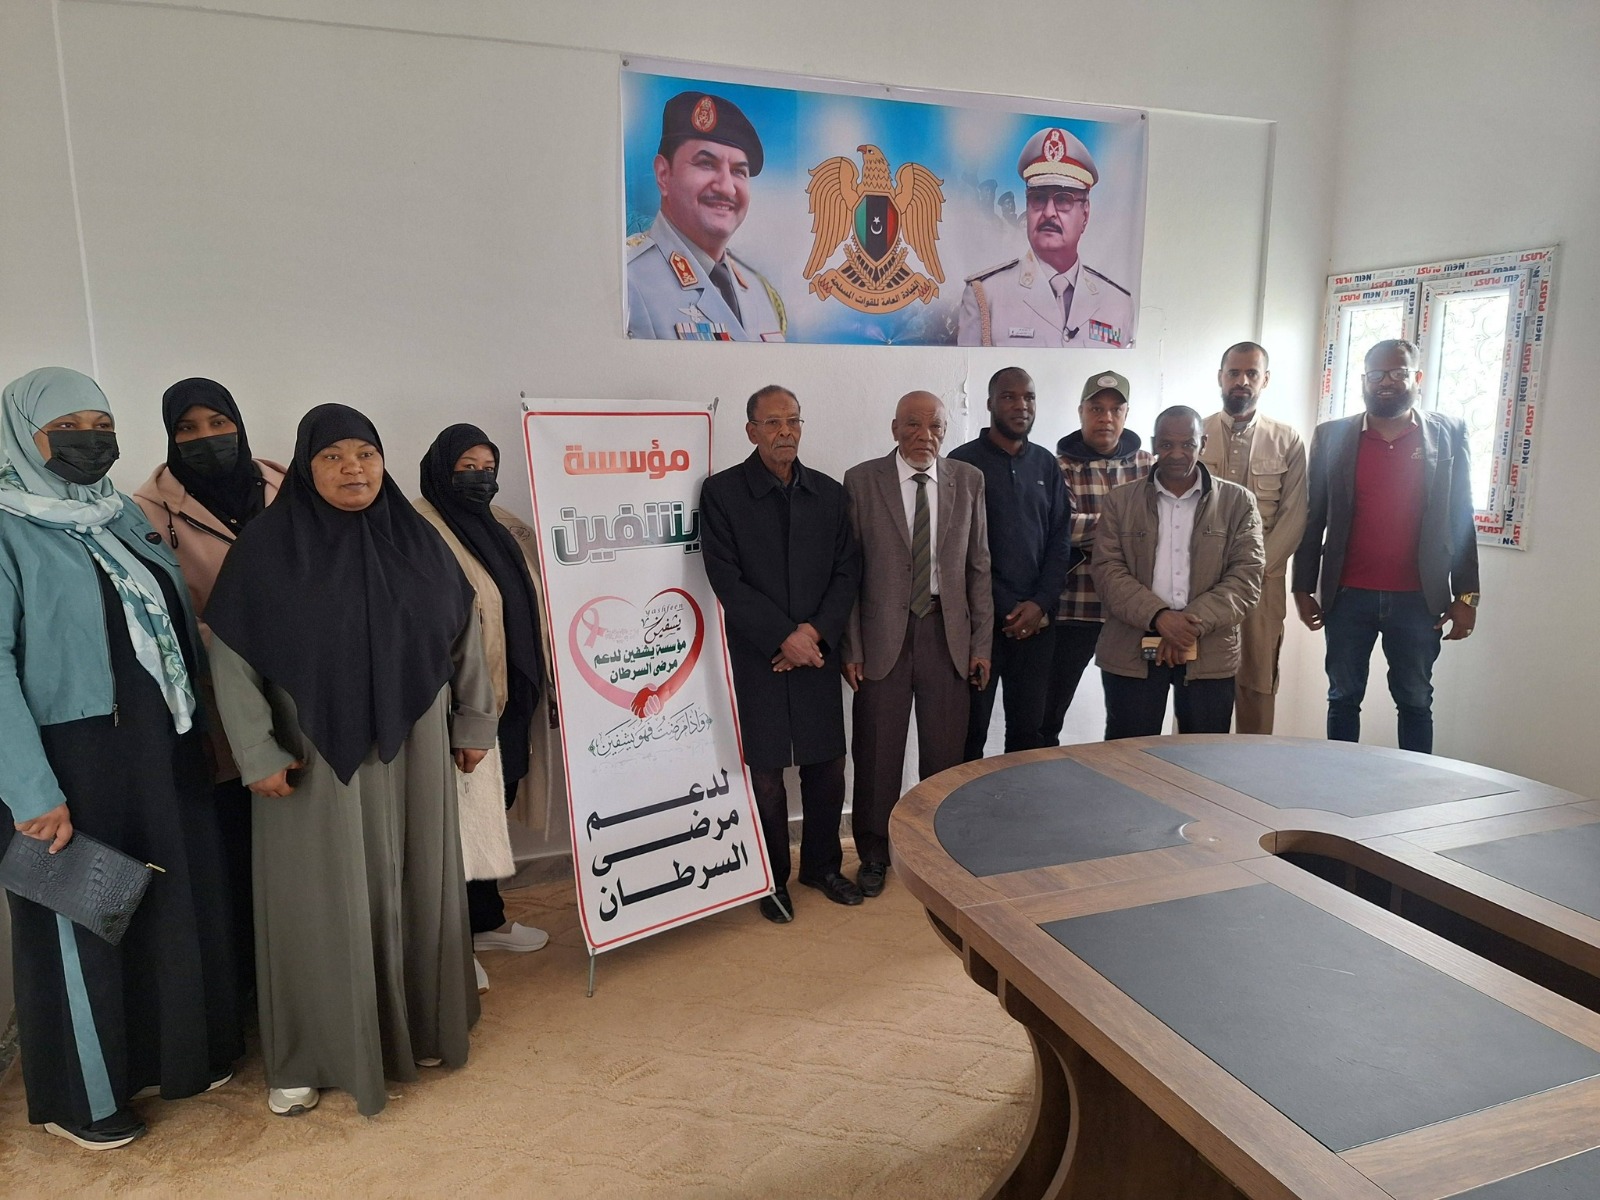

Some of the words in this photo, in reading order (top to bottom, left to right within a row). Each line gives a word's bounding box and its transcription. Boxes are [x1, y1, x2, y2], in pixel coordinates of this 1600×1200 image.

[1444, 262, 1465, 273] NEW
[830, 276, 854, 299] المسلحة
[1395, 277, 1415, 287] NEW
[1474, 276, 1501, 286] PLAST
[1504, 273, 1520, 283] EW
[855, 295, 880, 308] للقوات
[881, 295, 901, 307] العامة
[1340, 293, 1361, 302] PLAST
[1363, 291, 1381, 299] NEW
[1537, 280, 1549, 312] PLAST
[1534, 315, 1544, 342] NEW
[1522, 342, 1532, 374] PLAST
[1519, 376, 1528, 402] NEW
[1525, 404, 1535, 436] PLAST
[563, 439, 690, 480] مؤسسة
[1522, 439, 1531, 464] NEW
[1511, 463, 1519, 493] LAST
[551, 501, 702, 566] يشفين
[1477, 525, 1505, 535] PLAST
[1513, 524, 1521, 545] AST
[623, 644, 655, 663] يشفين
[656, 639, 687, 656] مؤسسة
[594, 649, 622, 668] لدعم
[653, 659, 678, 677] مرضى
[610, 662, 652, 684] السرطان
[599, 840, 749, 922] السرطان
